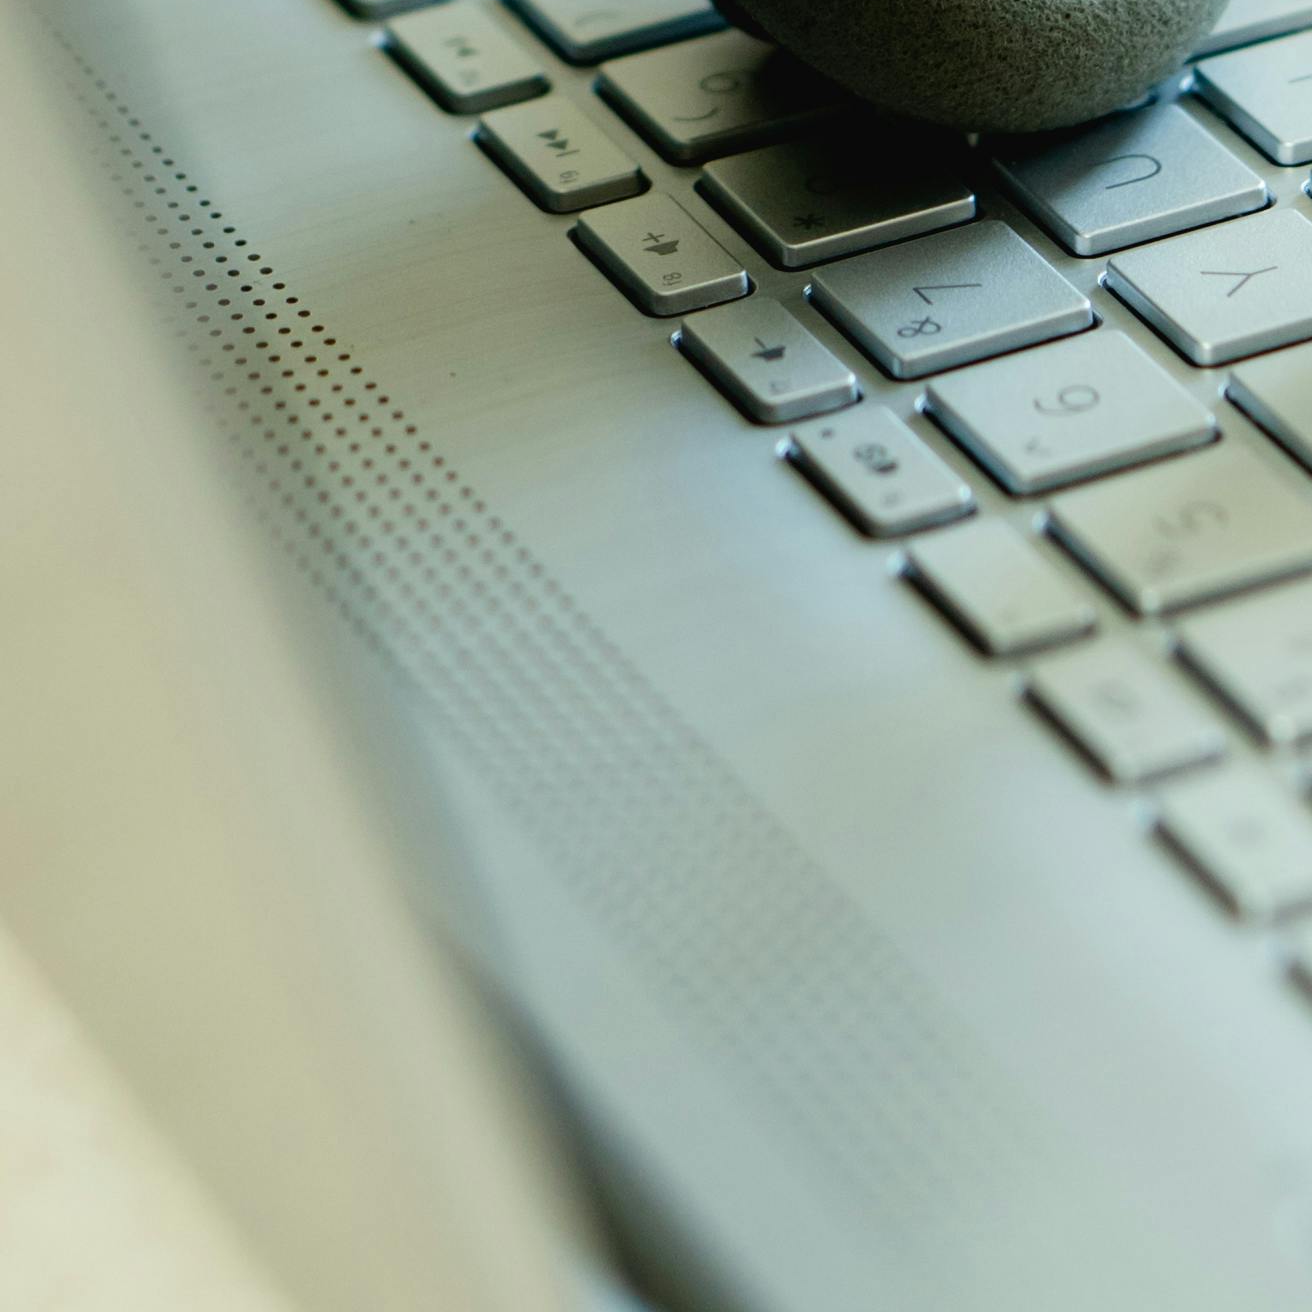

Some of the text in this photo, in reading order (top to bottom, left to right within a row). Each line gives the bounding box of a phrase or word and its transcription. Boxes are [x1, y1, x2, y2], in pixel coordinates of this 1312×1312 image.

[1091, 152, 1163, 191] U
[661, 270, 684, 288] f8
[1199, 264, 1280, 299] Y
[911, 282, 984, 307] 7
[896, 315, 943, 340] &
[1032, 383, 1103, 418] 6
